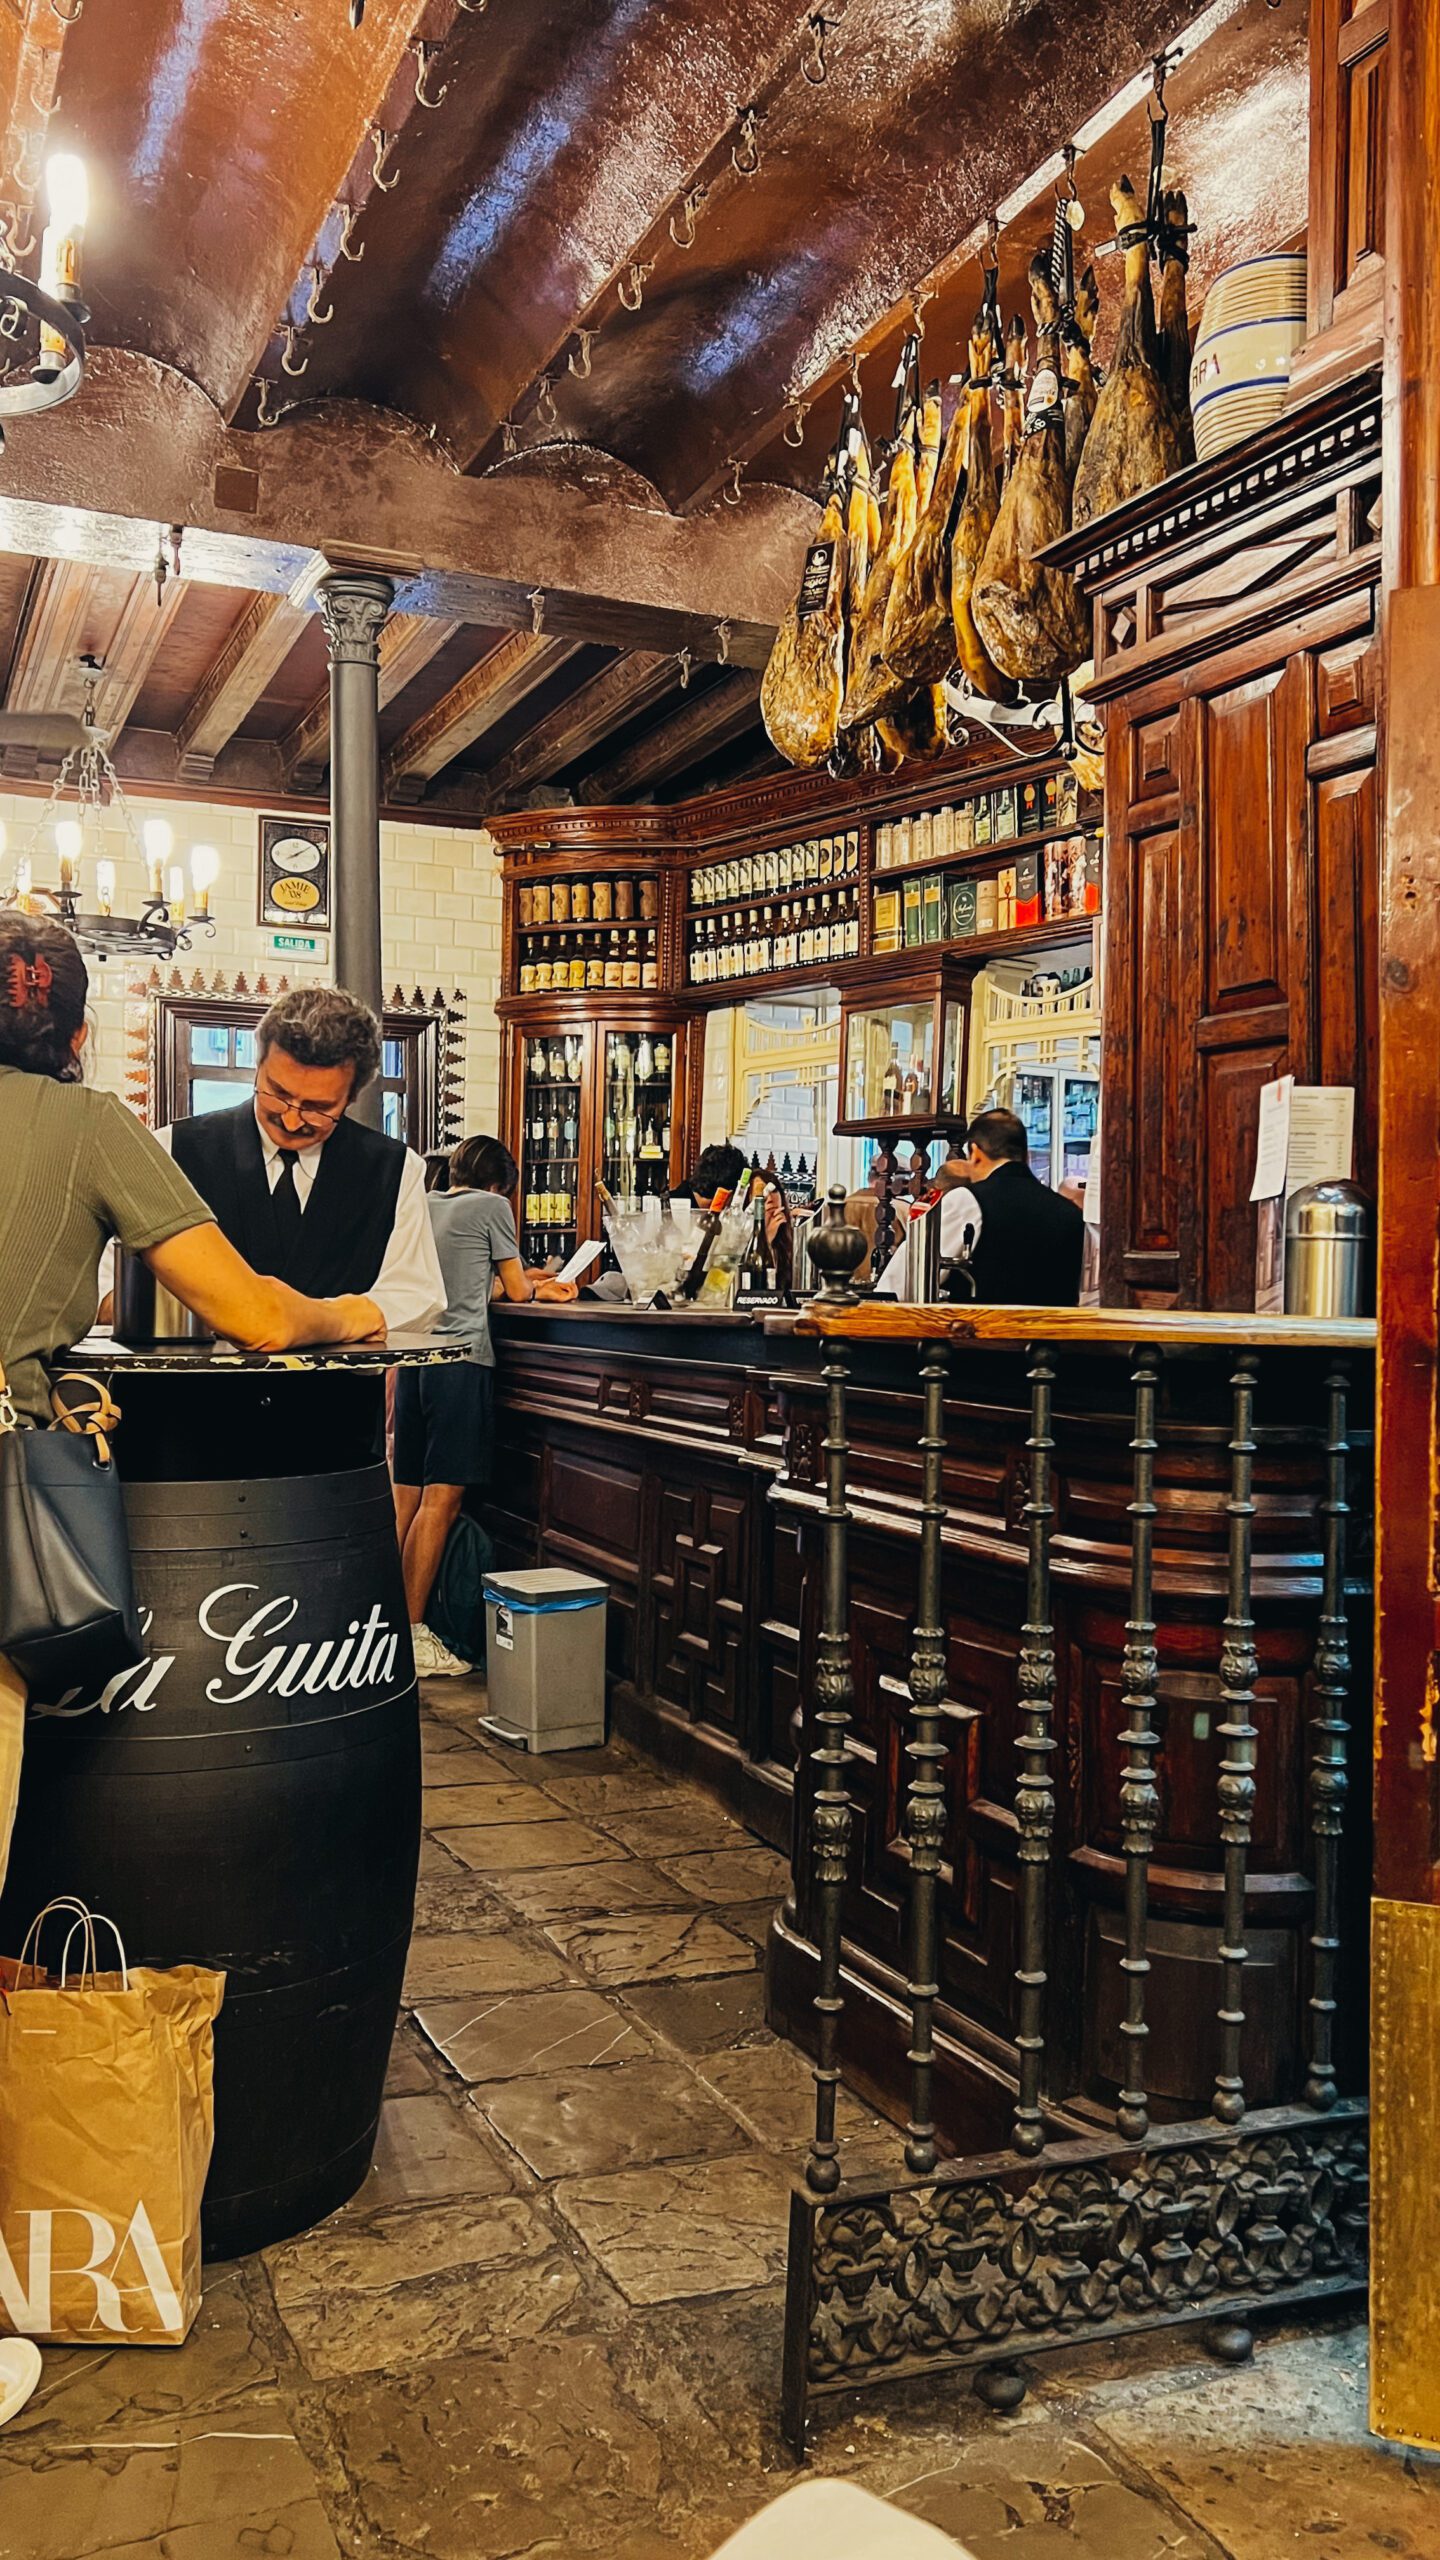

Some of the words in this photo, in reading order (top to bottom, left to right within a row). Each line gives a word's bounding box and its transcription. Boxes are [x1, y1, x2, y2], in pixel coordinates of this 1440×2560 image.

[1191, 353, 1220, 388] RRA
[279, 881, 311, 894] JAMIE
[278, 937, 311, 949] SALIDA
[736, 1296, 779, 1305] RESERVADO
[198, 1583, 399, 1704] Guita
